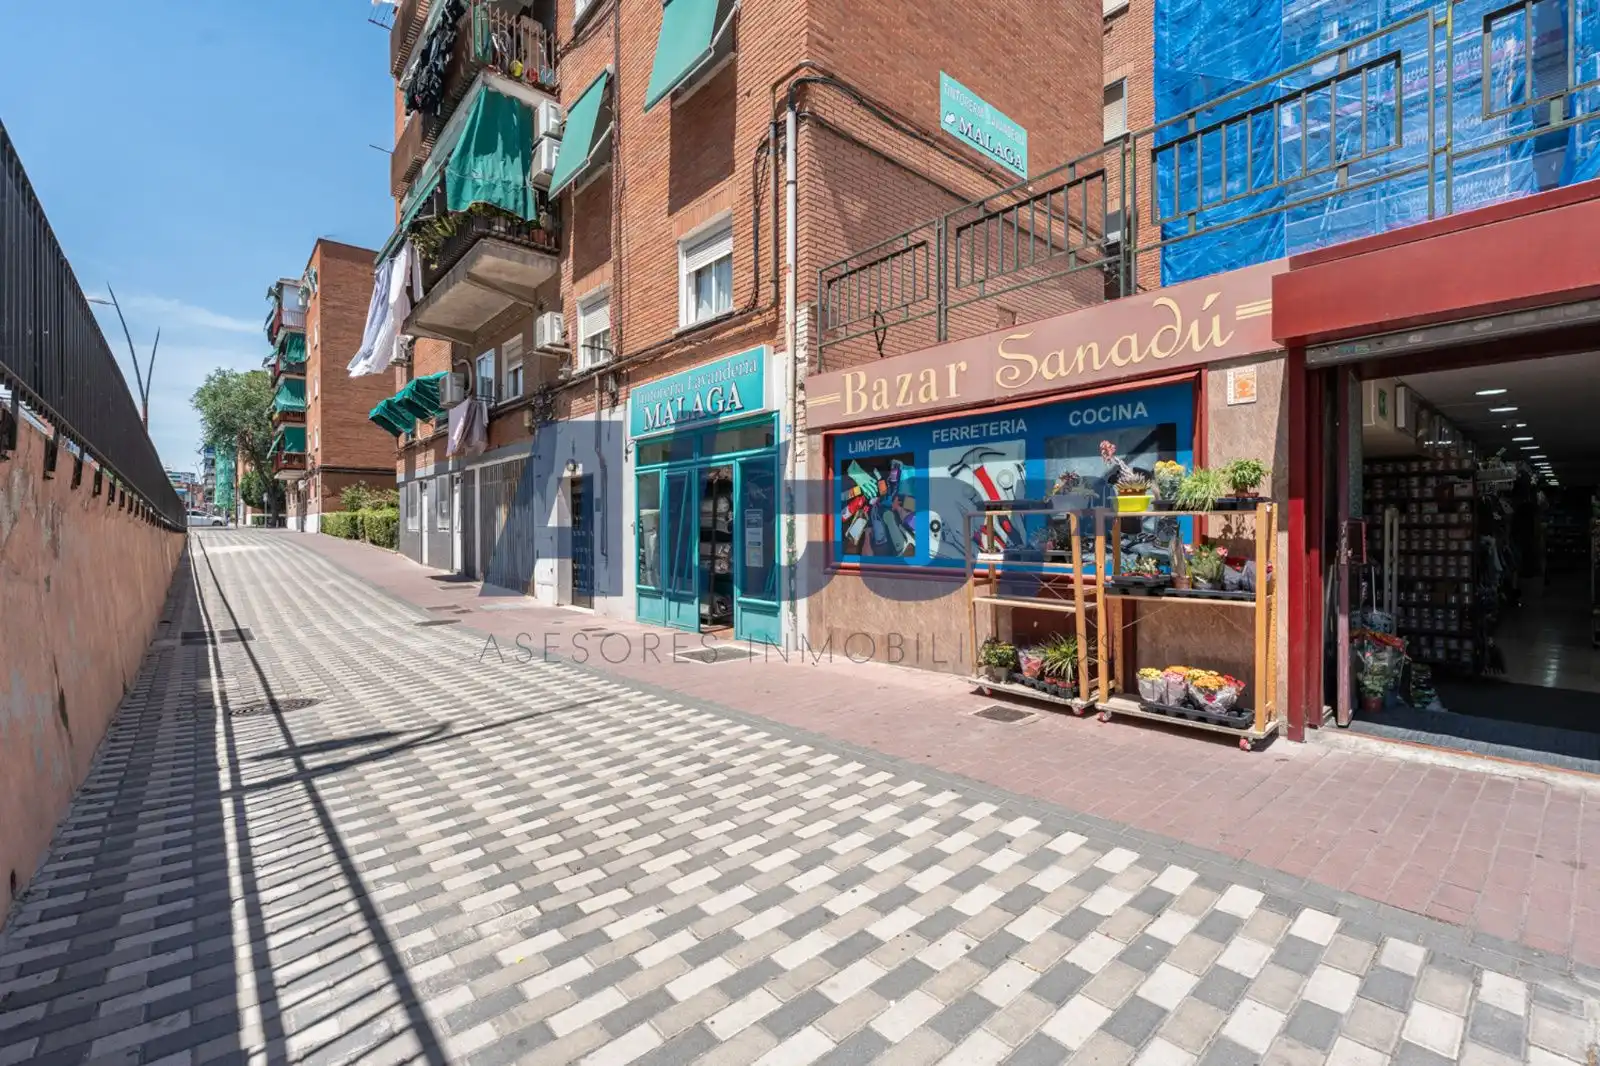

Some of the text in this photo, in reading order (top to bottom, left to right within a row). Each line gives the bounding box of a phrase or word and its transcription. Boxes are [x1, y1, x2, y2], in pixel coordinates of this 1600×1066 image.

[841, 359, 968, 416] Bazar
[995, 292, 1234, 389] Sanadú
[1069, 401, 1149, 426] COCINA
[849, 435, 902, 453] LIMPIEZA
